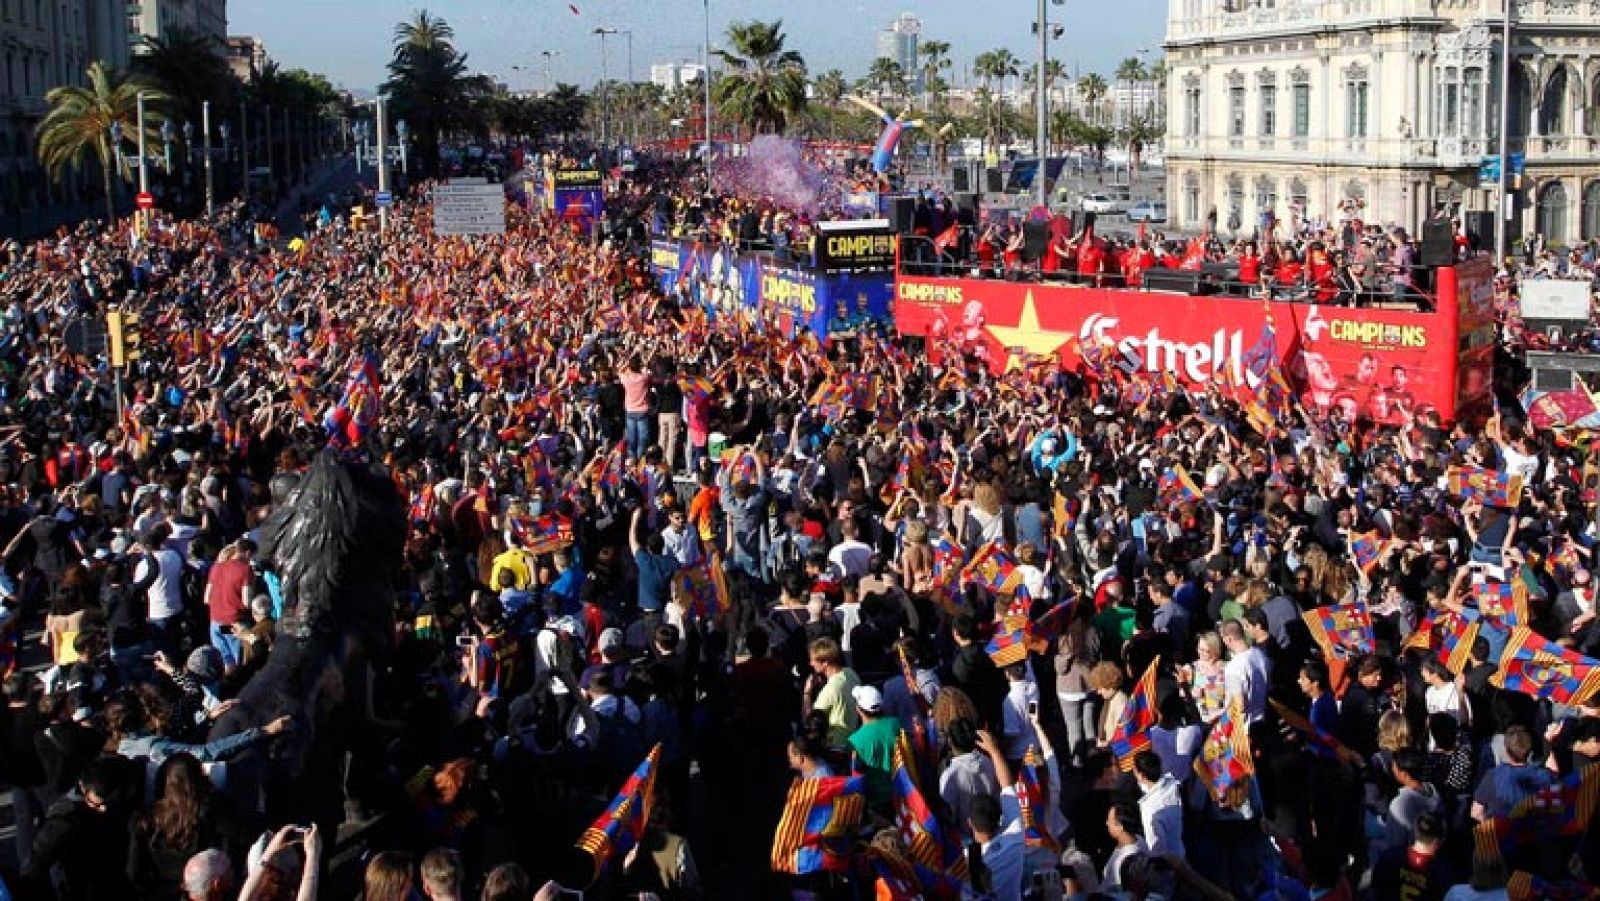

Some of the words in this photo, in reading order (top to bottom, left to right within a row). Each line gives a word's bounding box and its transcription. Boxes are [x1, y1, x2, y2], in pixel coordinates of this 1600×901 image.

[828, 235, 896, 257] CAMPIN
[762, 274, 816, 313] CAMPINS
[899, 282, 963, 304] CAMPINS
[1330, 319, 1426, 347] CAMPINS
[1079, 313, 1261, 388] Estrell
